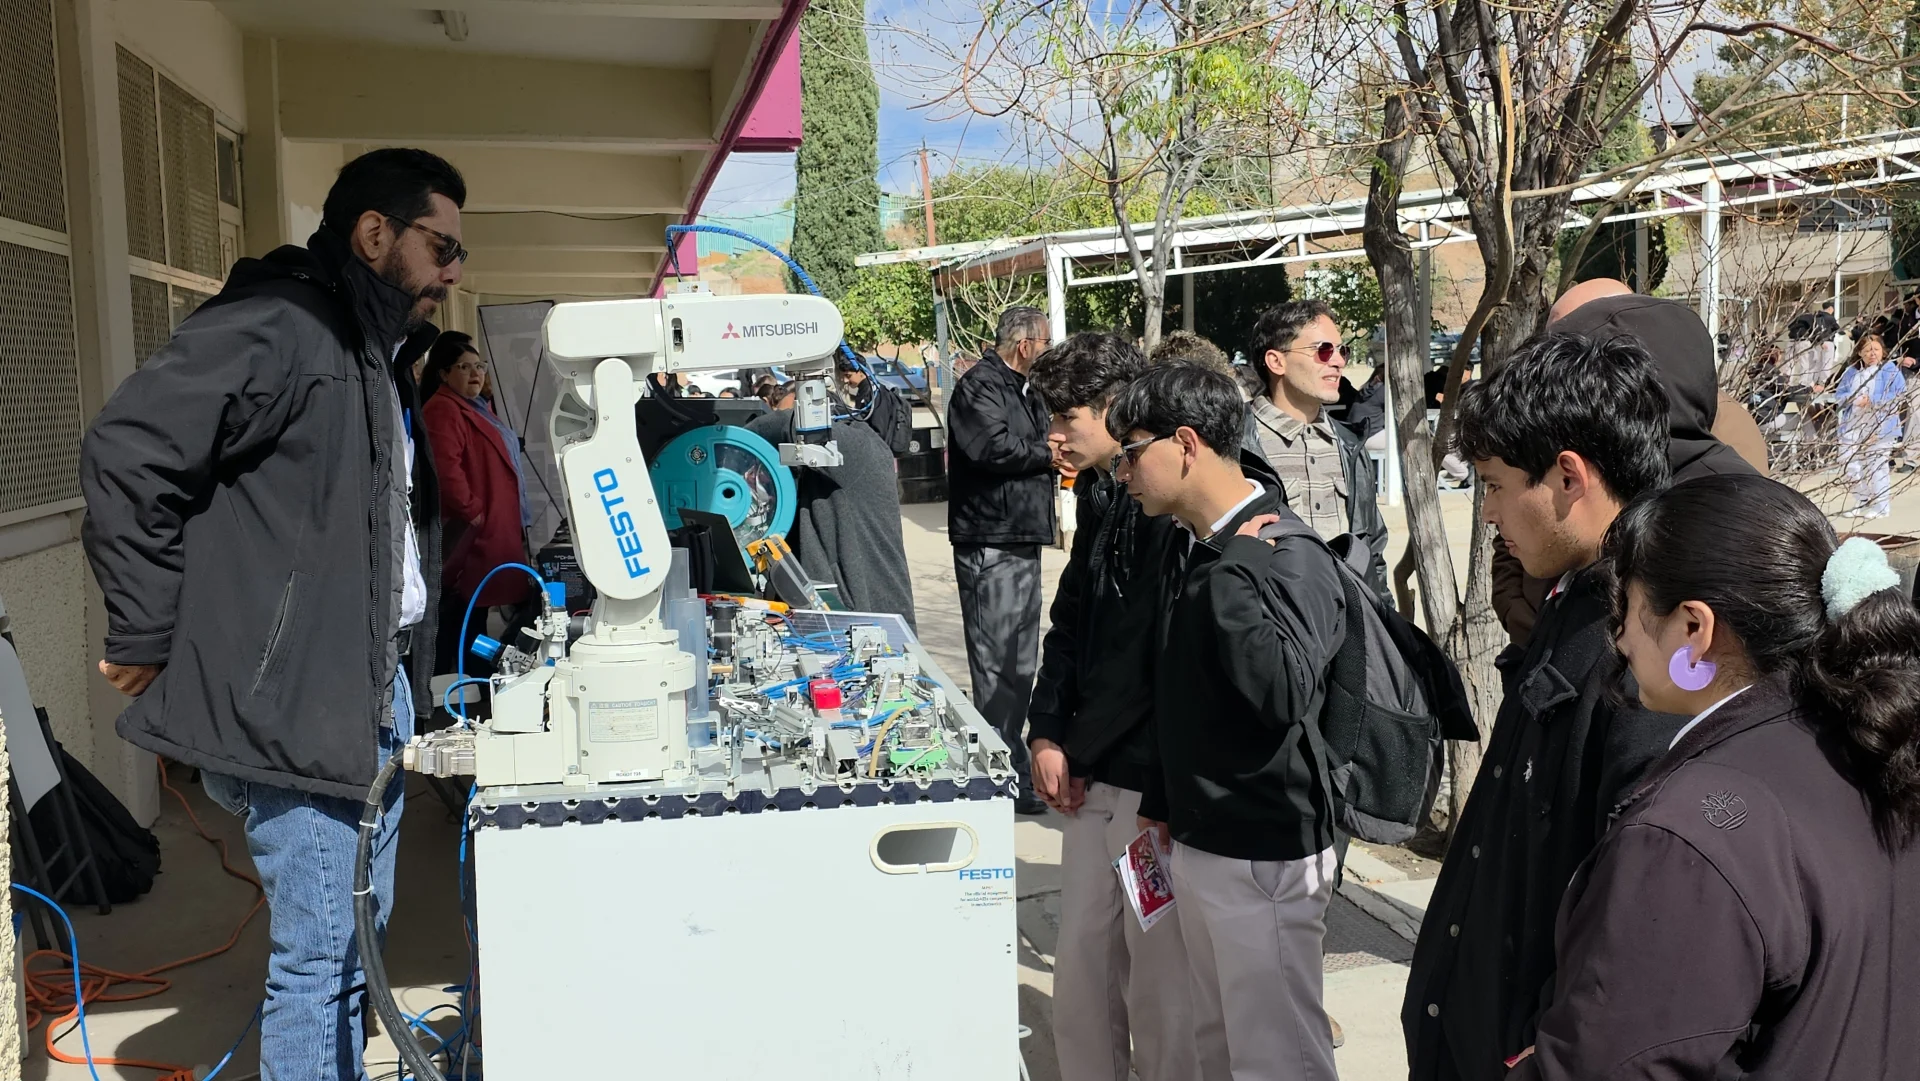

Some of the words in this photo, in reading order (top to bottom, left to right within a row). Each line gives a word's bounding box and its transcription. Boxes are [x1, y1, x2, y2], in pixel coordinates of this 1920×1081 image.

[742, 322, 818, 338] MITSUBISHI
[593, 467, 651, 579] FESTO
[959, 868, 1014, 880] FESTO
